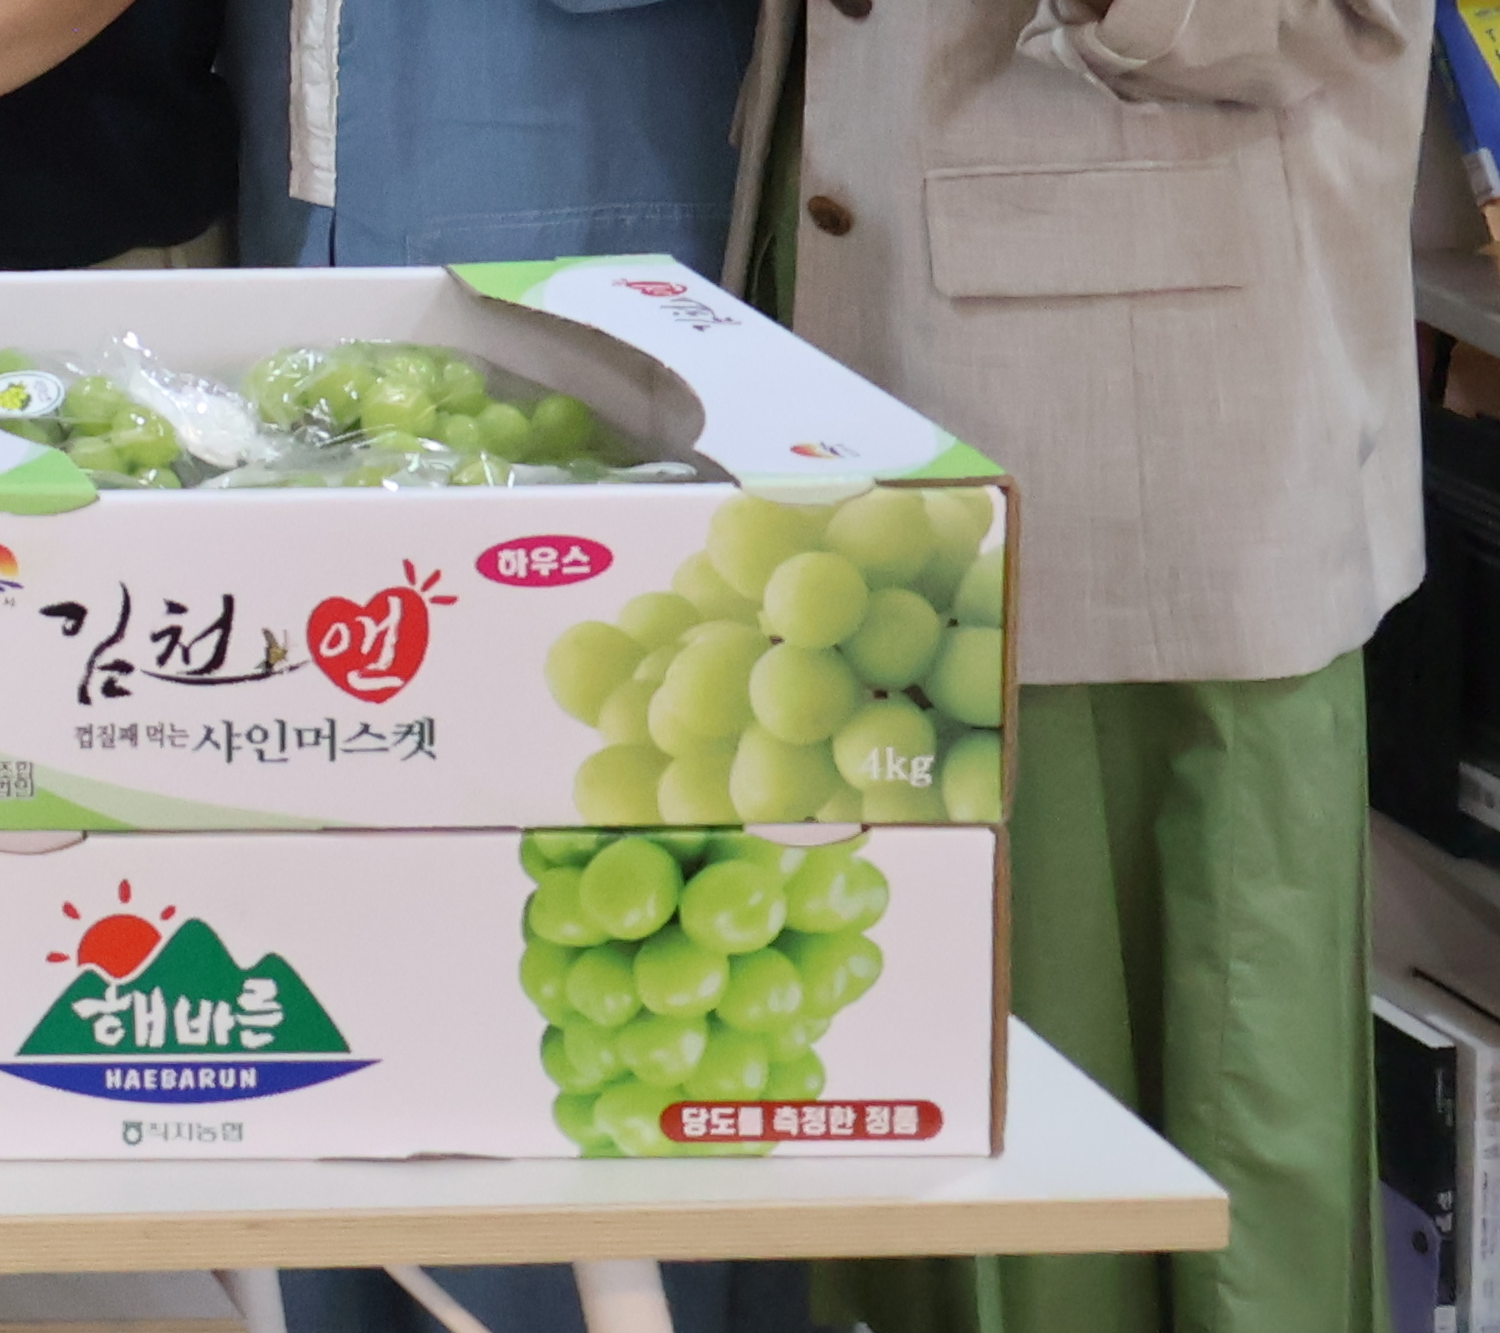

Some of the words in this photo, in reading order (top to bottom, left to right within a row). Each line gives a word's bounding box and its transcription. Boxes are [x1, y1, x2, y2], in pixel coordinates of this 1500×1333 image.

[497, 545, 592, 578] 하우스
[38, 580, 236, 706] 김천
[319, 593, 406, 690] 앤
[145, 722, 191, 750] 먹는
[192, 716, 438, 765] 샤인머스켓
[860, 746, 935, 788] 4kg
[71, 978, 284, 1049] 해바른
[104, 1067, 258, 1091] HAEBARUN
